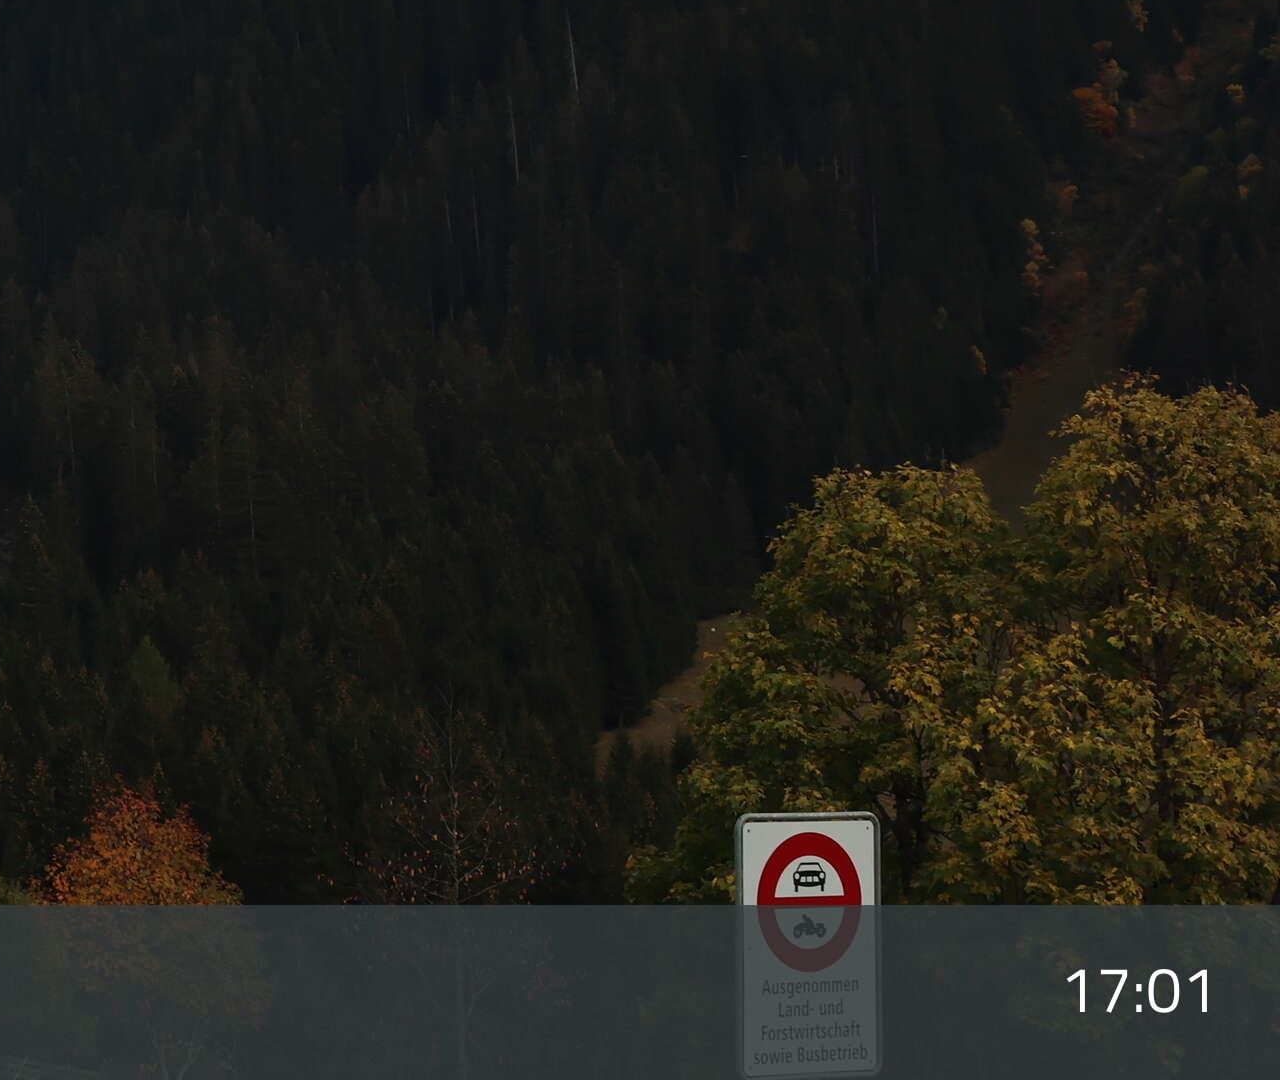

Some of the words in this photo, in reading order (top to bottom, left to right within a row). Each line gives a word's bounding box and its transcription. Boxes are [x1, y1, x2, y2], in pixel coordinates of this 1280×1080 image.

[761, 979, 859, 998] Ausgenommen
[778, 999, 815, 1018] Land-
[820, 998, 844, 1015] und
[761, 1020, 860, 1041] Forstwirtschaft
[754, 1047, 792, 1064] sowie
[797, 1043, 868, 1062] Busbetrieb
